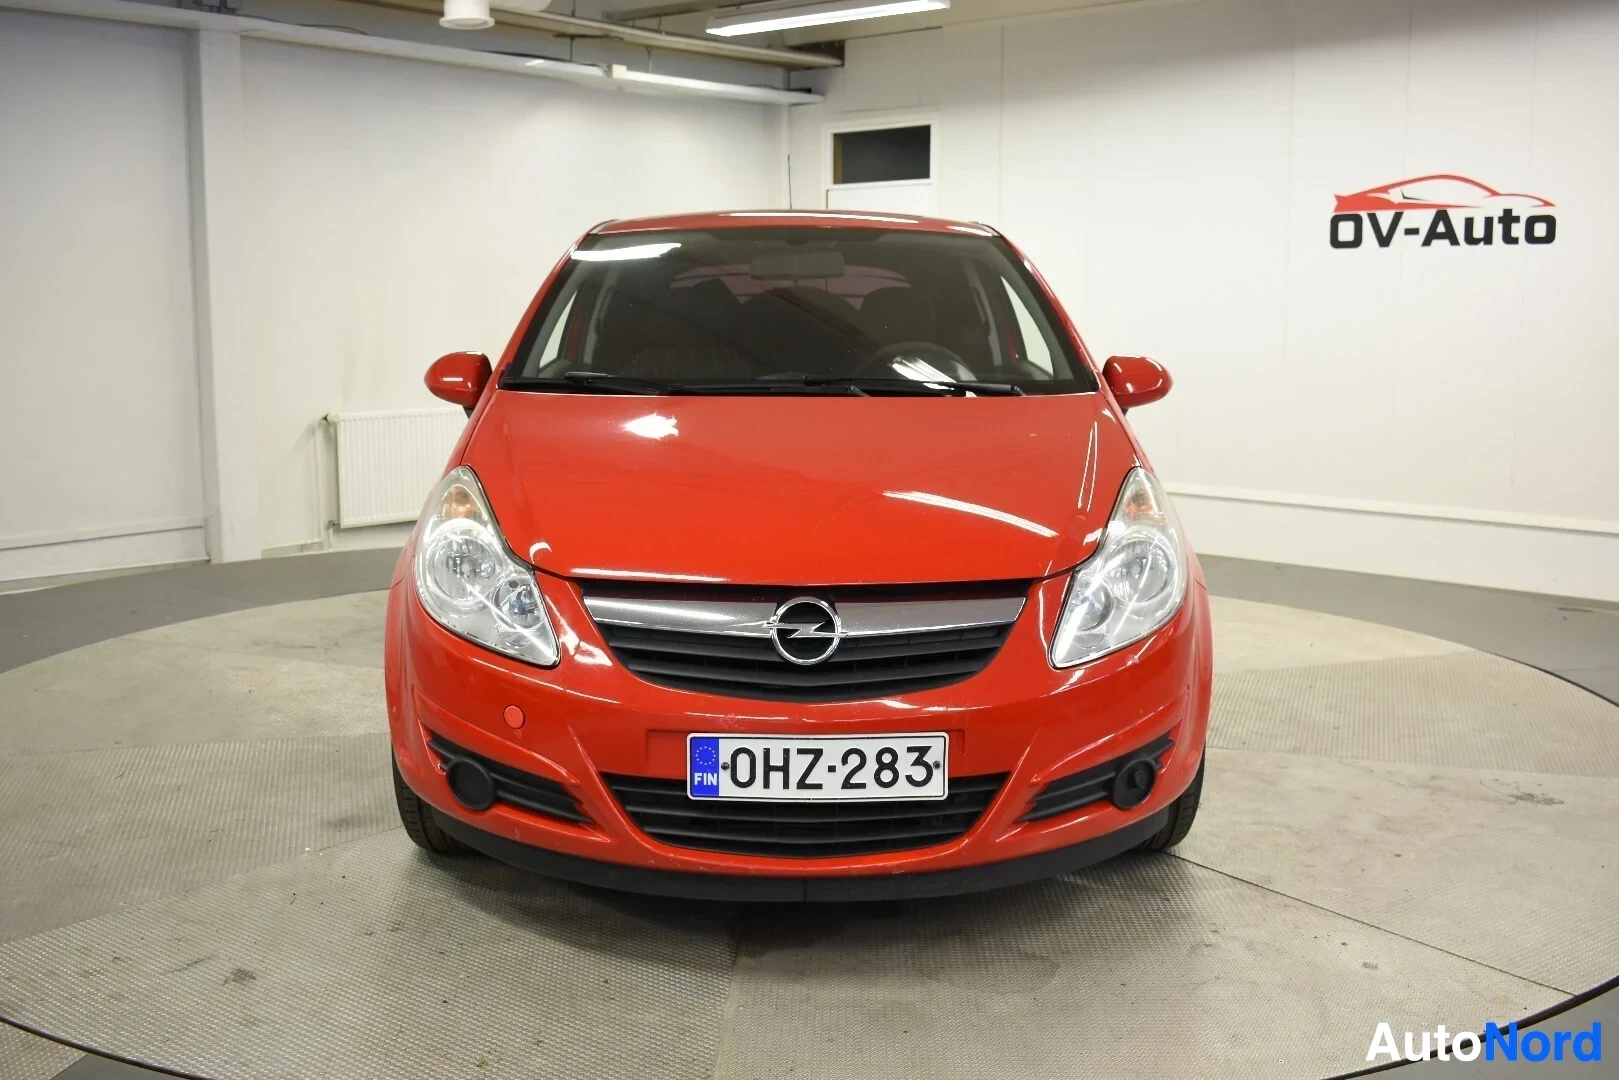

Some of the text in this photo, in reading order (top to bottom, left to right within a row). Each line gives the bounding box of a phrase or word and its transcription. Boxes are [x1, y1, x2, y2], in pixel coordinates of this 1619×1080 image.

[1329, 208, 1557, 249] OV-Auto
[694, 772, 718, 786] FIN
[730, 745, 934, 790] OHZ-283
